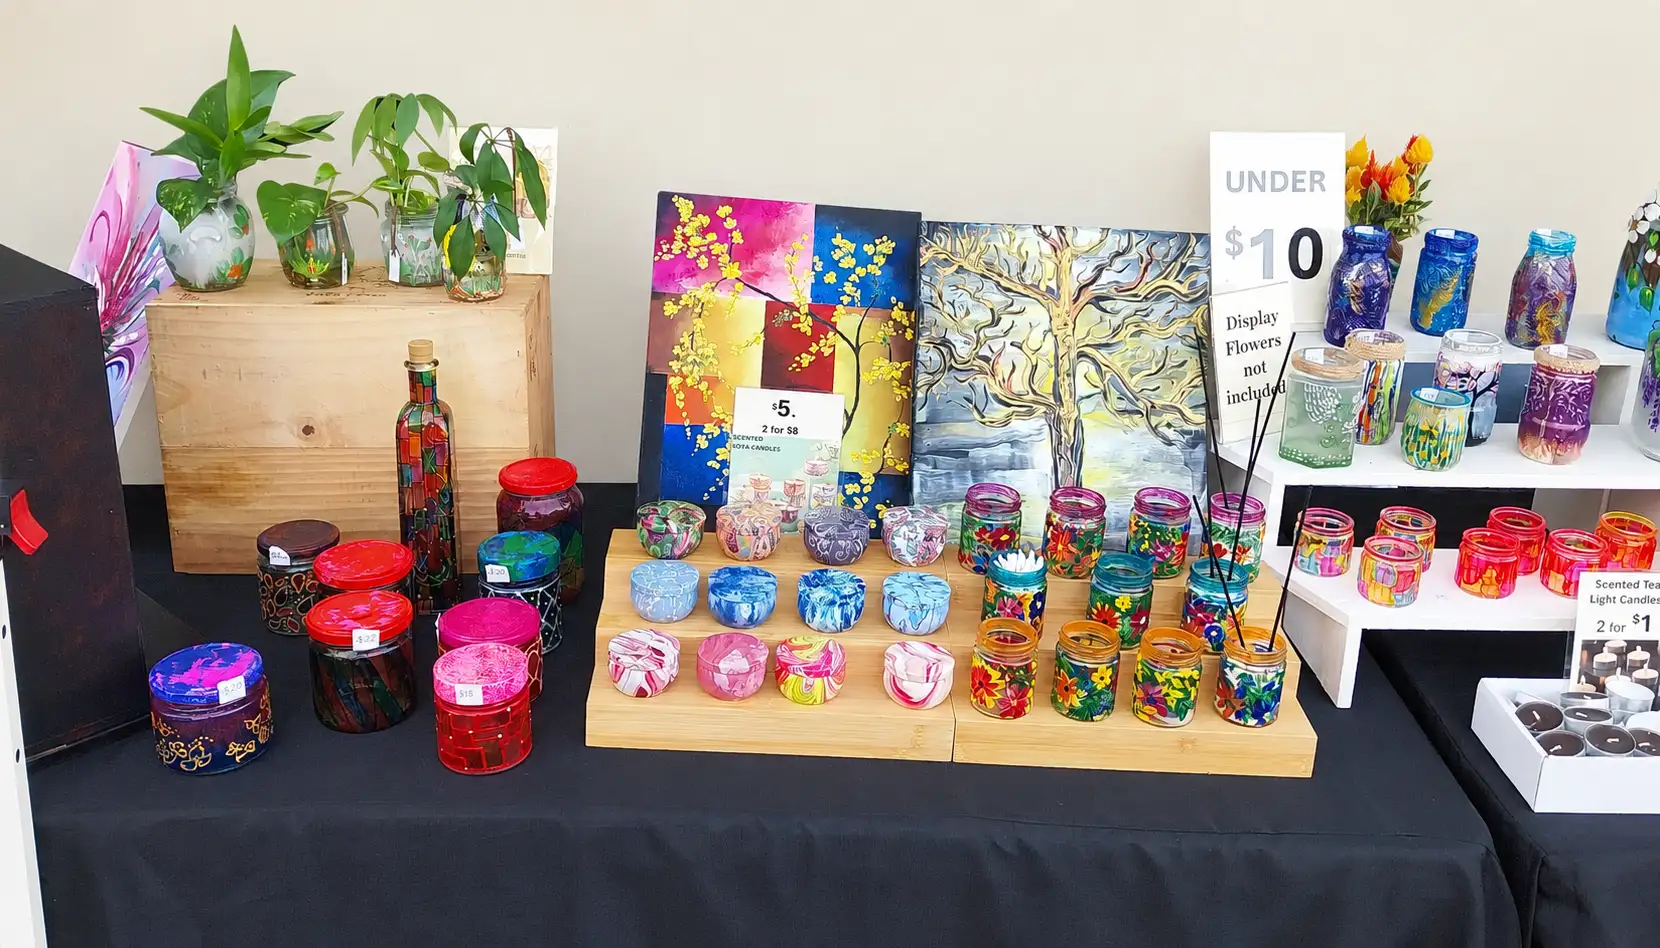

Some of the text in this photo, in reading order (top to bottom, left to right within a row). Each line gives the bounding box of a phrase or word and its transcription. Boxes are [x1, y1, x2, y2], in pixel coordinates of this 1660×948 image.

[1226, 170, 1326, 193] UNDER
[1225, 226, 1323, 280] $10
[1226, 310, 1279, 331] Display
[1225, 336, 1282, 357] Flowers
[1243, 360, 1268, 378] not
[1226, 380, 1287, 406] included
[733, 434, 764, 442] SCENTED
[762, 425, 799, 435] 2 for $8
[751, 444, 781, 453] CANDLES
[1595, 579, 1660, 590] Scented Tea
[1590, 594, 1660, 606] Light Candles
[1596, 613, 1651, 633] 2 for $1
